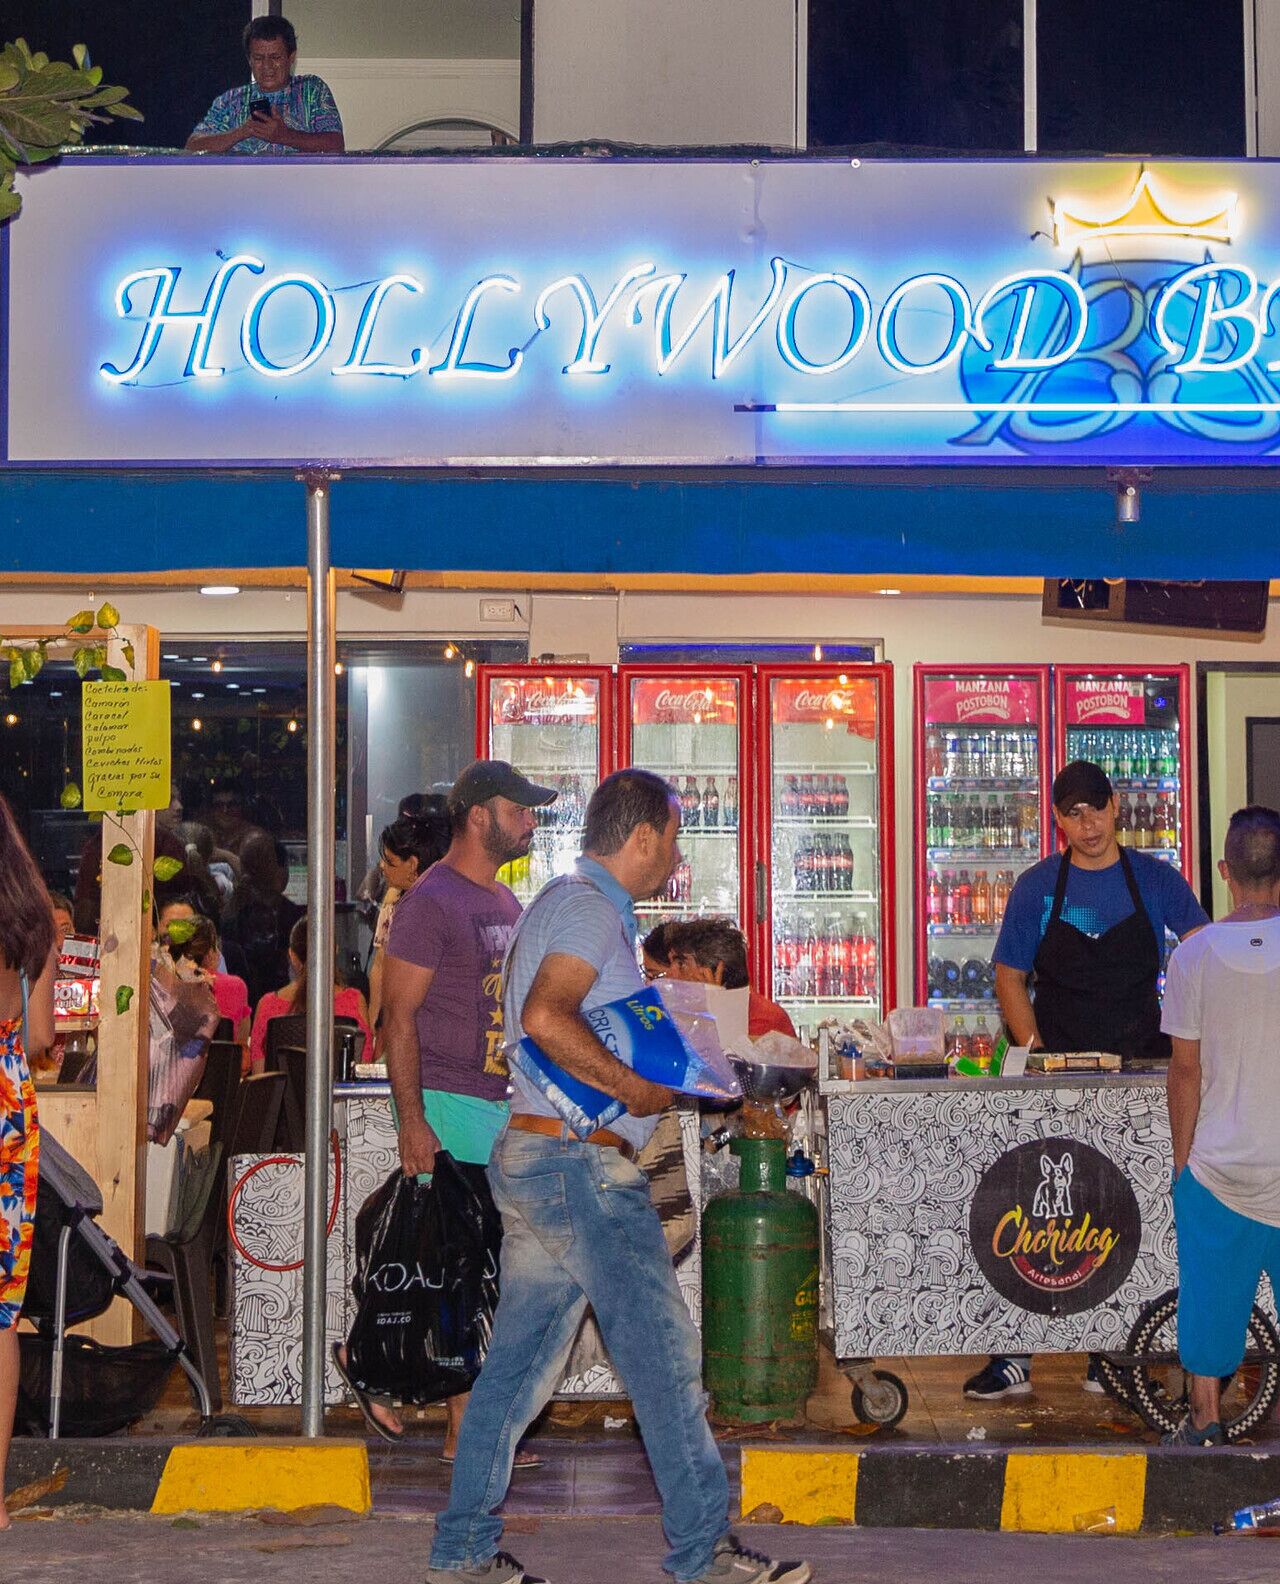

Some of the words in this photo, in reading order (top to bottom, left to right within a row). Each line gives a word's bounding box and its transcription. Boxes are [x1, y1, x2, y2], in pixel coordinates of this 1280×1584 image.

[100, 254, 1090, 384] HOLLYWOOD
[955, 680, 1010, 693] MANZANA
[1076, 680, 1130, 693] MANZANA
[992, 1204, 1121, 1268] Choridog
[1027, 1268, 1083, 1287] Artesanal
